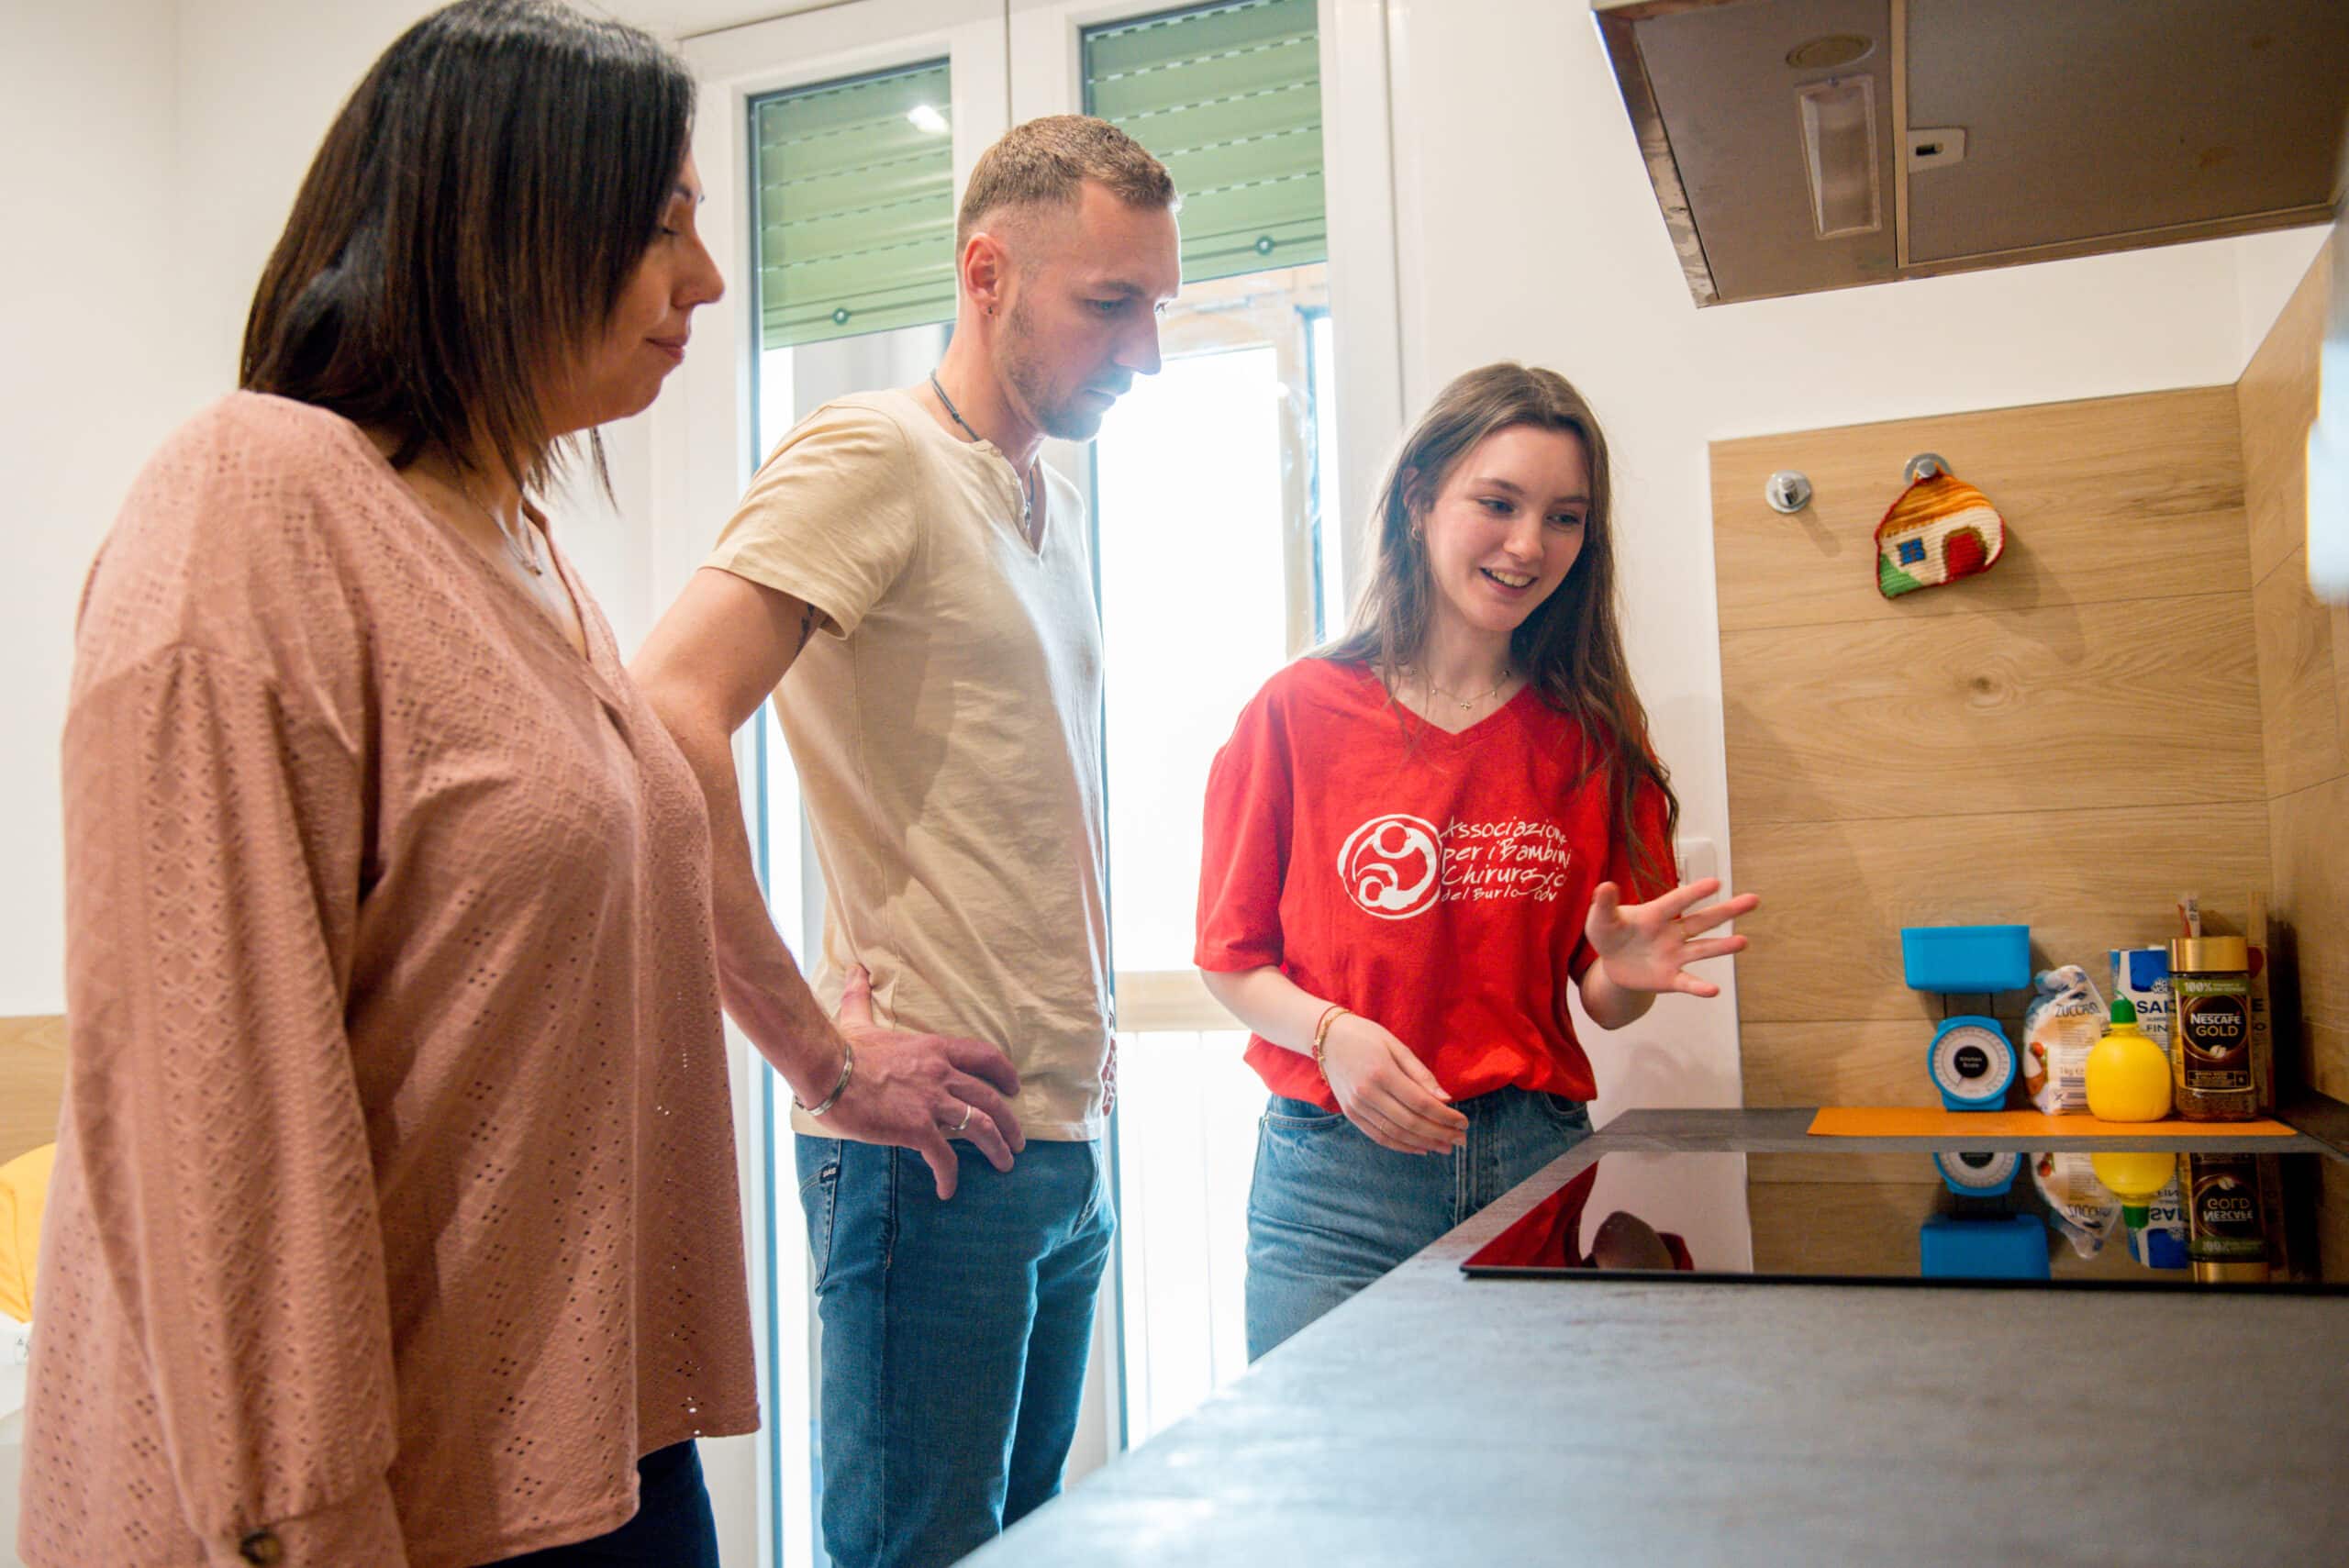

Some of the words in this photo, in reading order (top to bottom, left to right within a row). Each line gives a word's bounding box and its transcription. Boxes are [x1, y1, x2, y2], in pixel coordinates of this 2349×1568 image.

[1439, 816, 1567, 844] Associazione
[1442, 846, 1483, 874] per
[1442, 863, 1569, 888] Chirurgic
[1442, 886, 1470, 902] del
[1473, 884, 1520, 900] Burlo
[2146, 1024, 2169, 1033] FIN
[2196, 1026, 2239, 1037] GOLD
